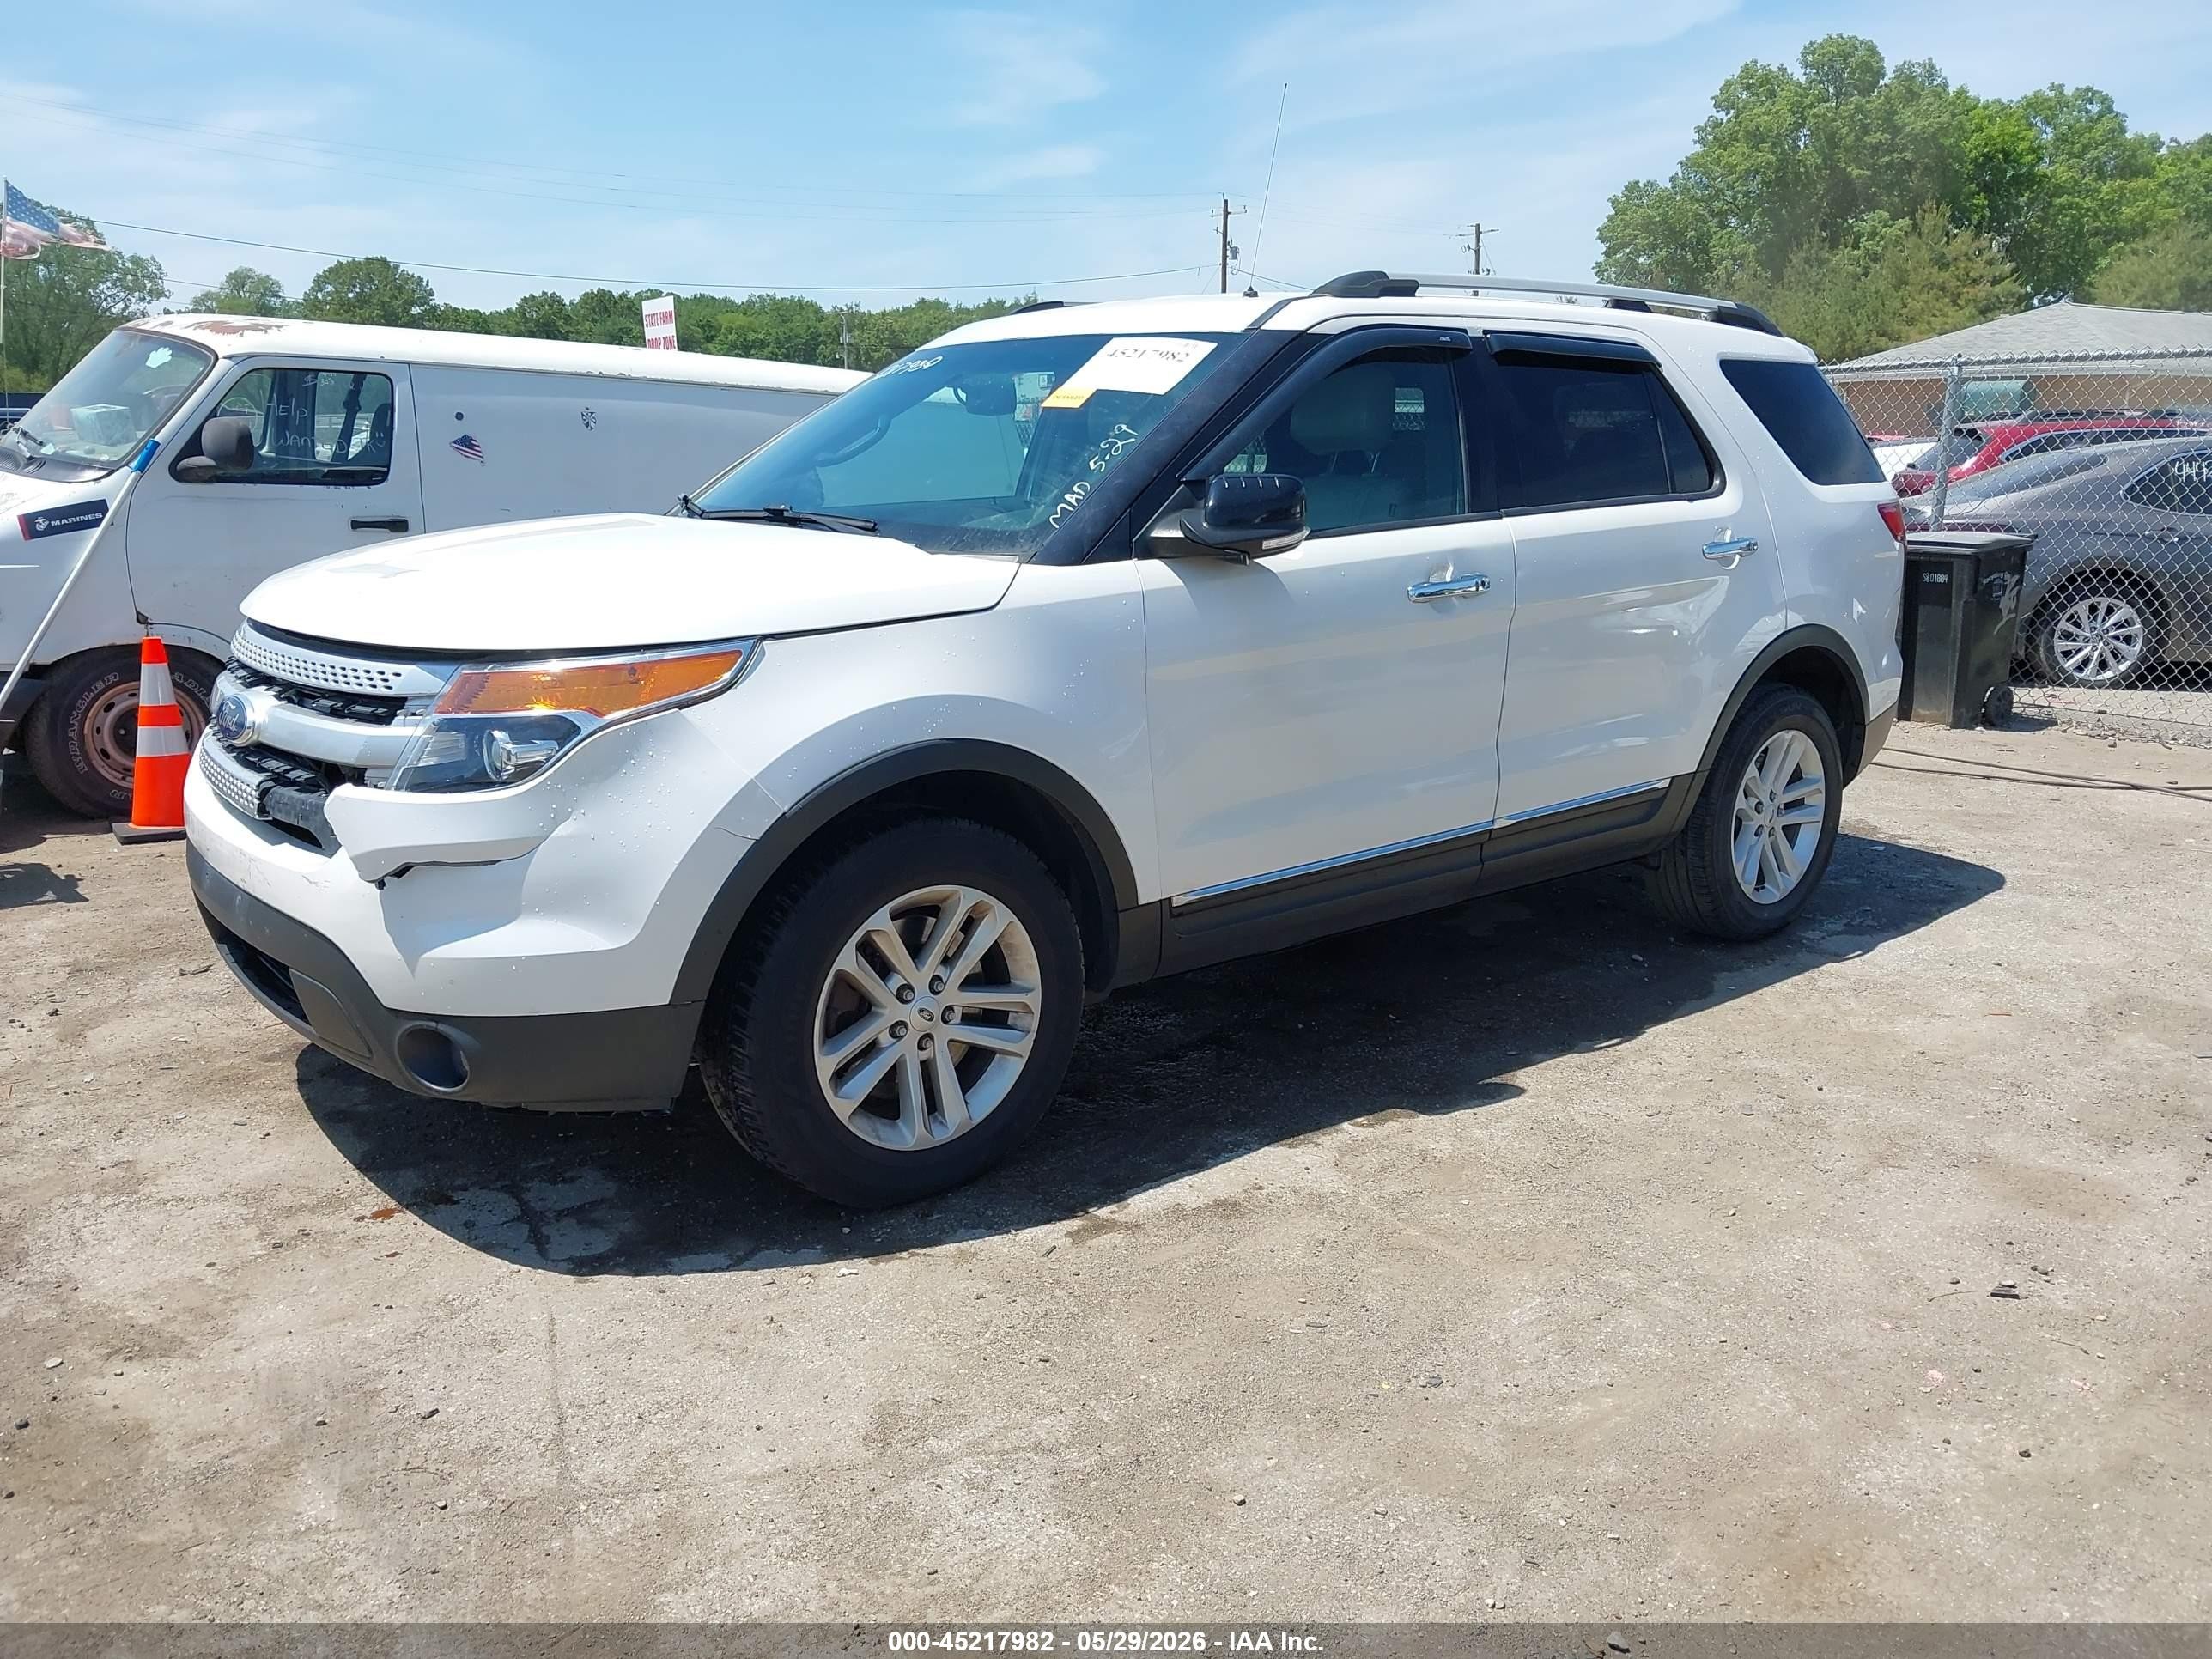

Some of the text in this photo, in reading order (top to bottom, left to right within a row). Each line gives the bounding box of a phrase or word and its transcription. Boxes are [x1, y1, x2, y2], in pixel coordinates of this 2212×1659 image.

[645, 310, 673, 328] STATE FARM
[647, 335, 676, 350] DROP ZONE
[1049, 423, 1139, 529] MAD 5-29
[51, 512, 103, 527] MARINES
[68, 672, 120, 775] WRANGLER
